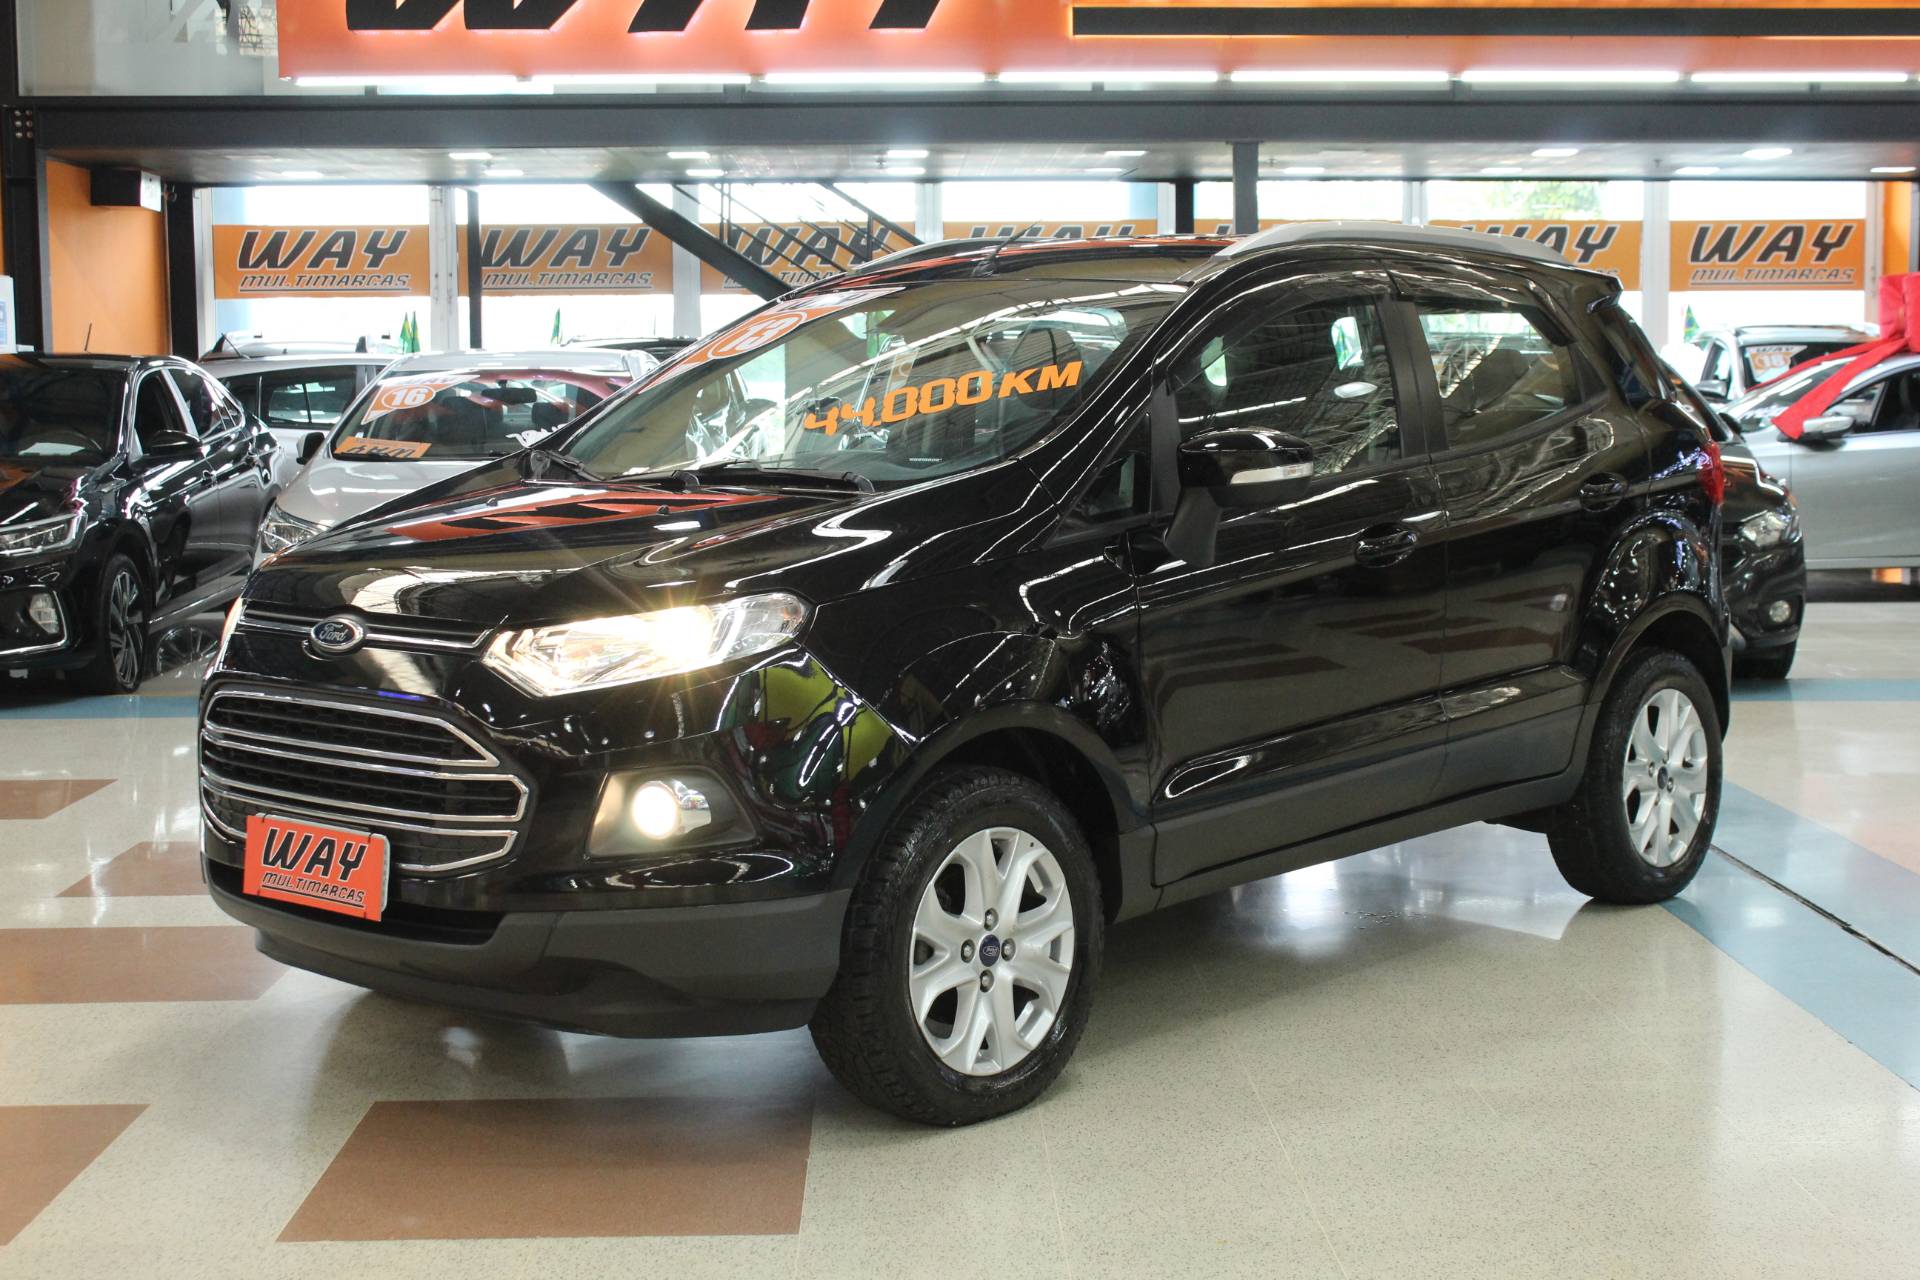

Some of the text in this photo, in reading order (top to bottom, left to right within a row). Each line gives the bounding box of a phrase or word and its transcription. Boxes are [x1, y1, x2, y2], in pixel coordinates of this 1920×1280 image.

[237, 229, 409, 271] WAY
[480, 226, 652, 268] WAY
[1459, 224, 1620, 265] AY
[1689, 223, 1856, 264] WAY
[240, 273, 411, 288] MULTIMARCAS
[483, 272, 653, 287] MULTIMARCAS
[1690, 267, 1855, 282] MULTIMARCAS
[391, 387, 428, 406] 16
[803, 360, 1083, 436] 44.000 KM
[319, 623, 350, 641] Ford
[261, 827, 368, 882] WAY
[262, 872, 365, 904] MULTIMARCAS
